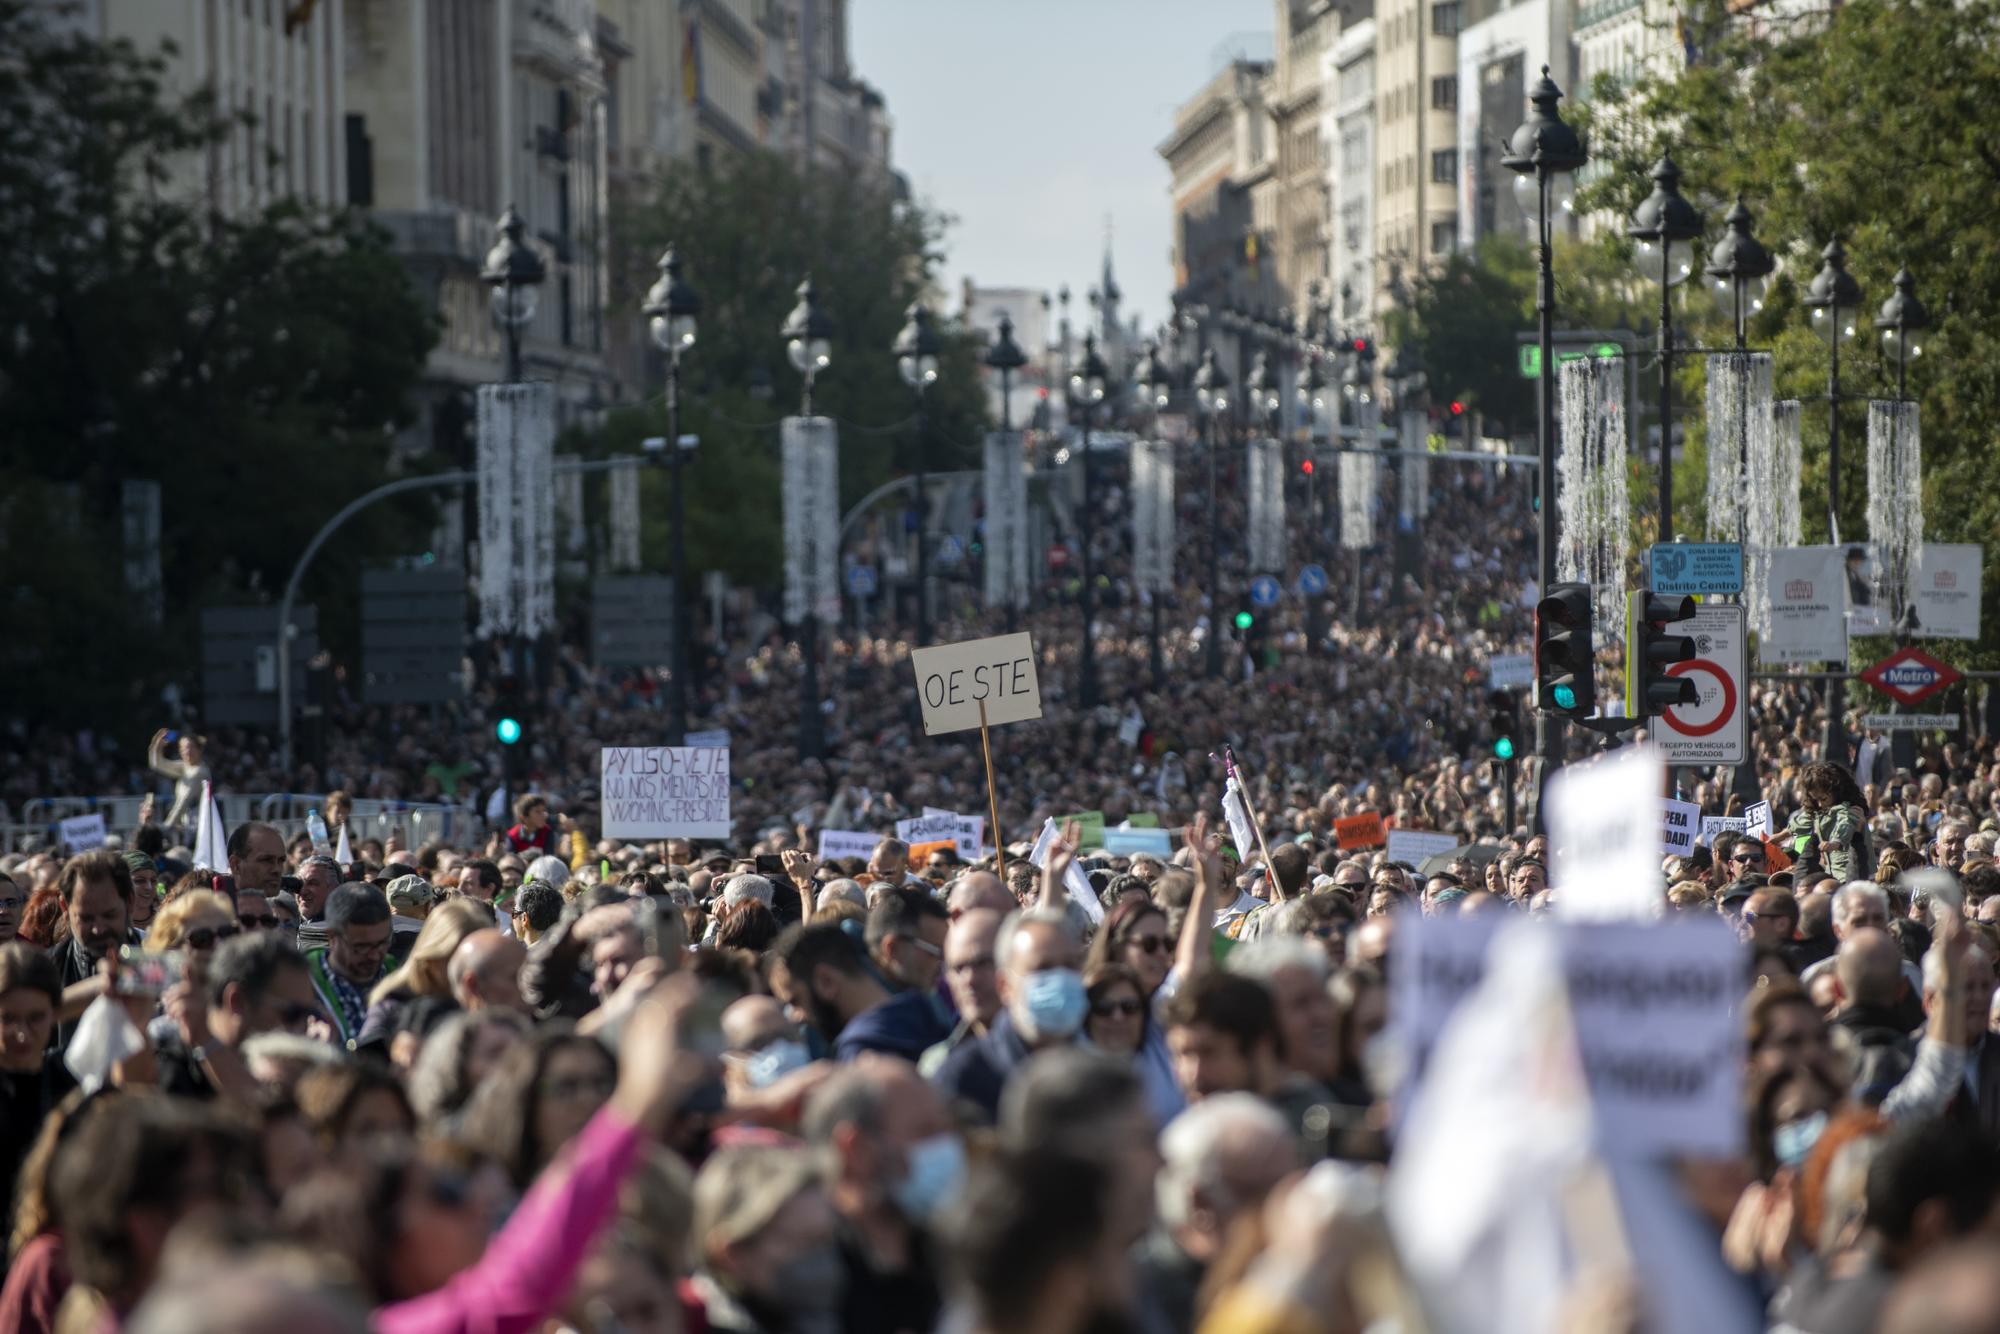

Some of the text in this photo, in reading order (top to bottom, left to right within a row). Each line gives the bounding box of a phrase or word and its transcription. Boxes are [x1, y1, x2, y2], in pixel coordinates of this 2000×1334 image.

[1658, 581, 1739, 591] Distrito Centro
[1889, 669, 1932, 682] Metro
[925, 658, 1030, 709] OESTE
[1868, 716, 1954, 728] Banco de España
[1672, 750, 1724, 758] AUTORIZADOS
[605, 777, 625, 799] NO
[630, 776, 656, 800] NOS
